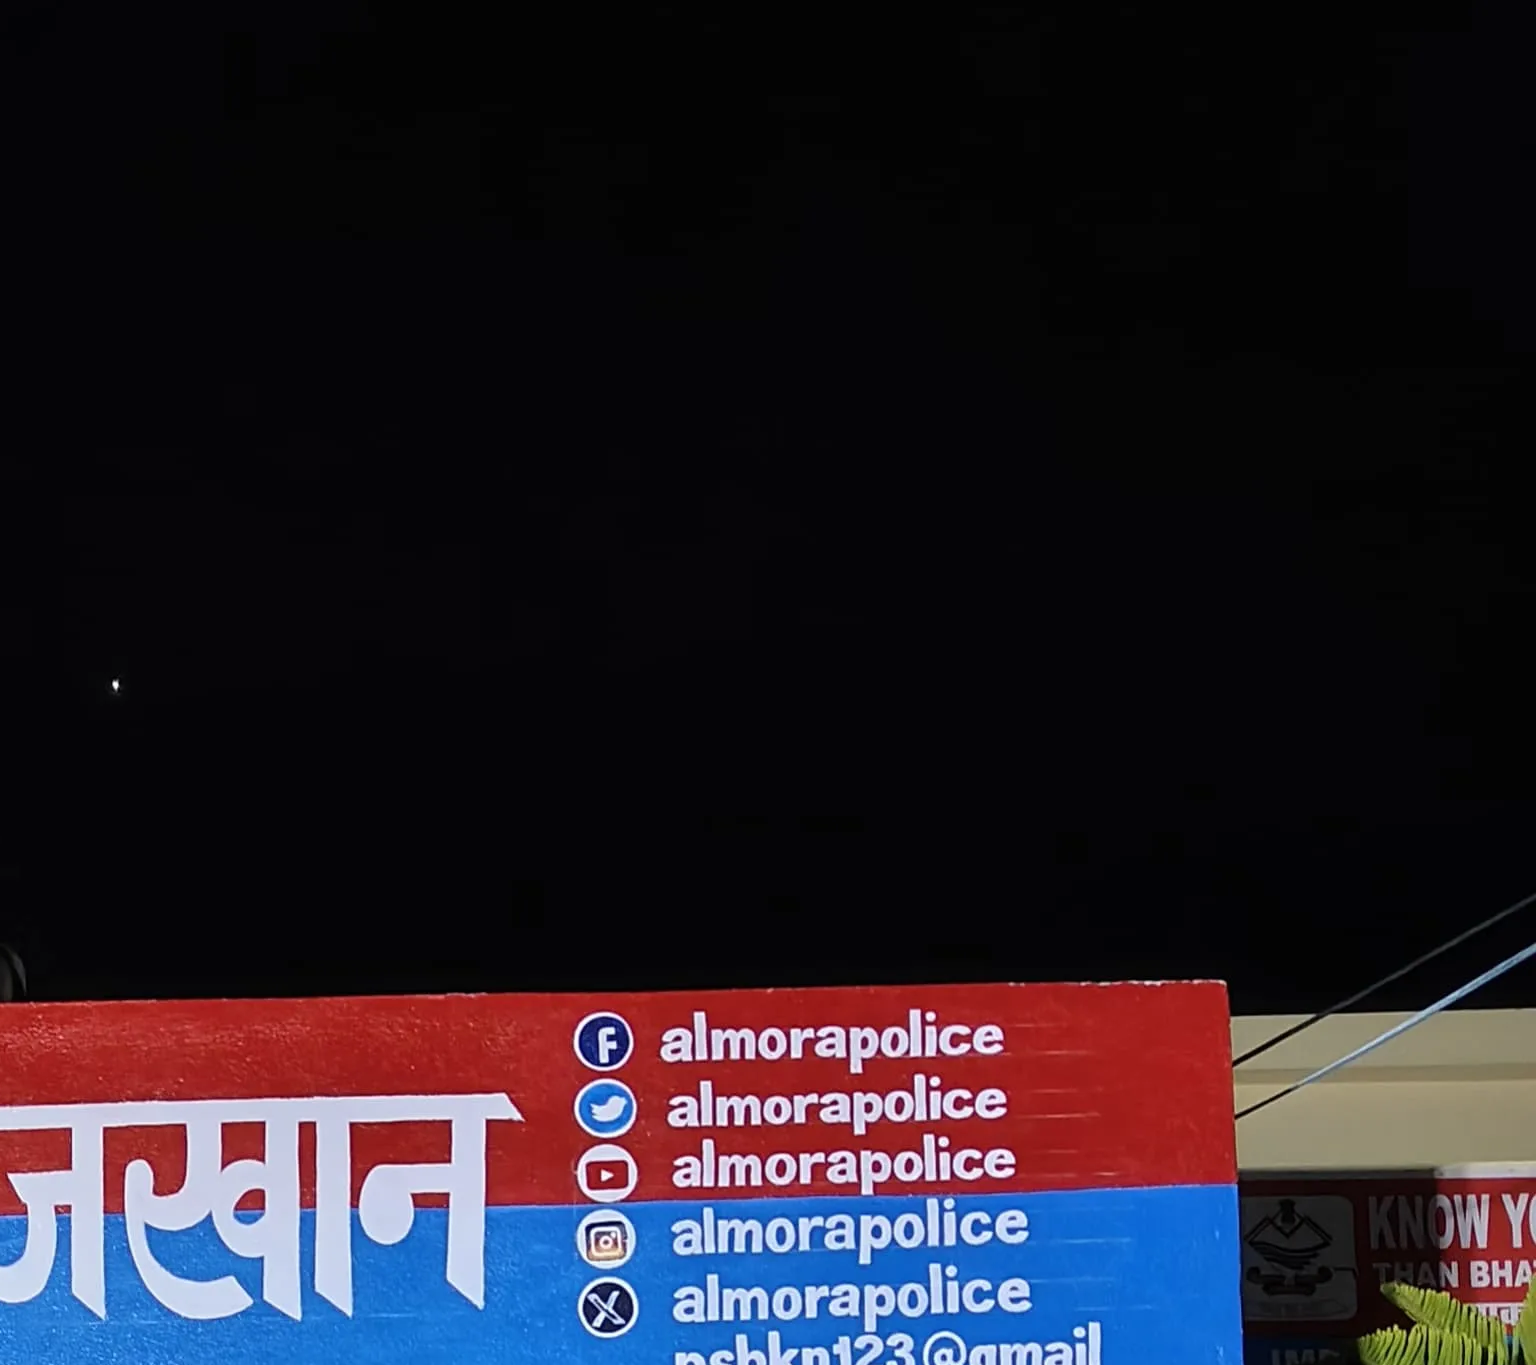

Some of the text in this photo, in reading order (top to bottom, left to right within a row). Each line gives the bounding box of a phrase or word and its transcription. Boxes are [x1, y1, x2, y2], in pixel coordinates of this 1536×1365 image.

[660, 1009, 1004, 1074] almorapolice
[667, 1074, 1007, 1136] almorapolice
[672, 1134, 1016, 1196] almorapolice
[671, 1198, 1029, 1265] almorapolice
[1368, 1193, 1536, 1250] KNOW Y
[672, 1264, 1032, 1333] almorapolice
[1372, 1260, 1536, 1289] THAN BHA
